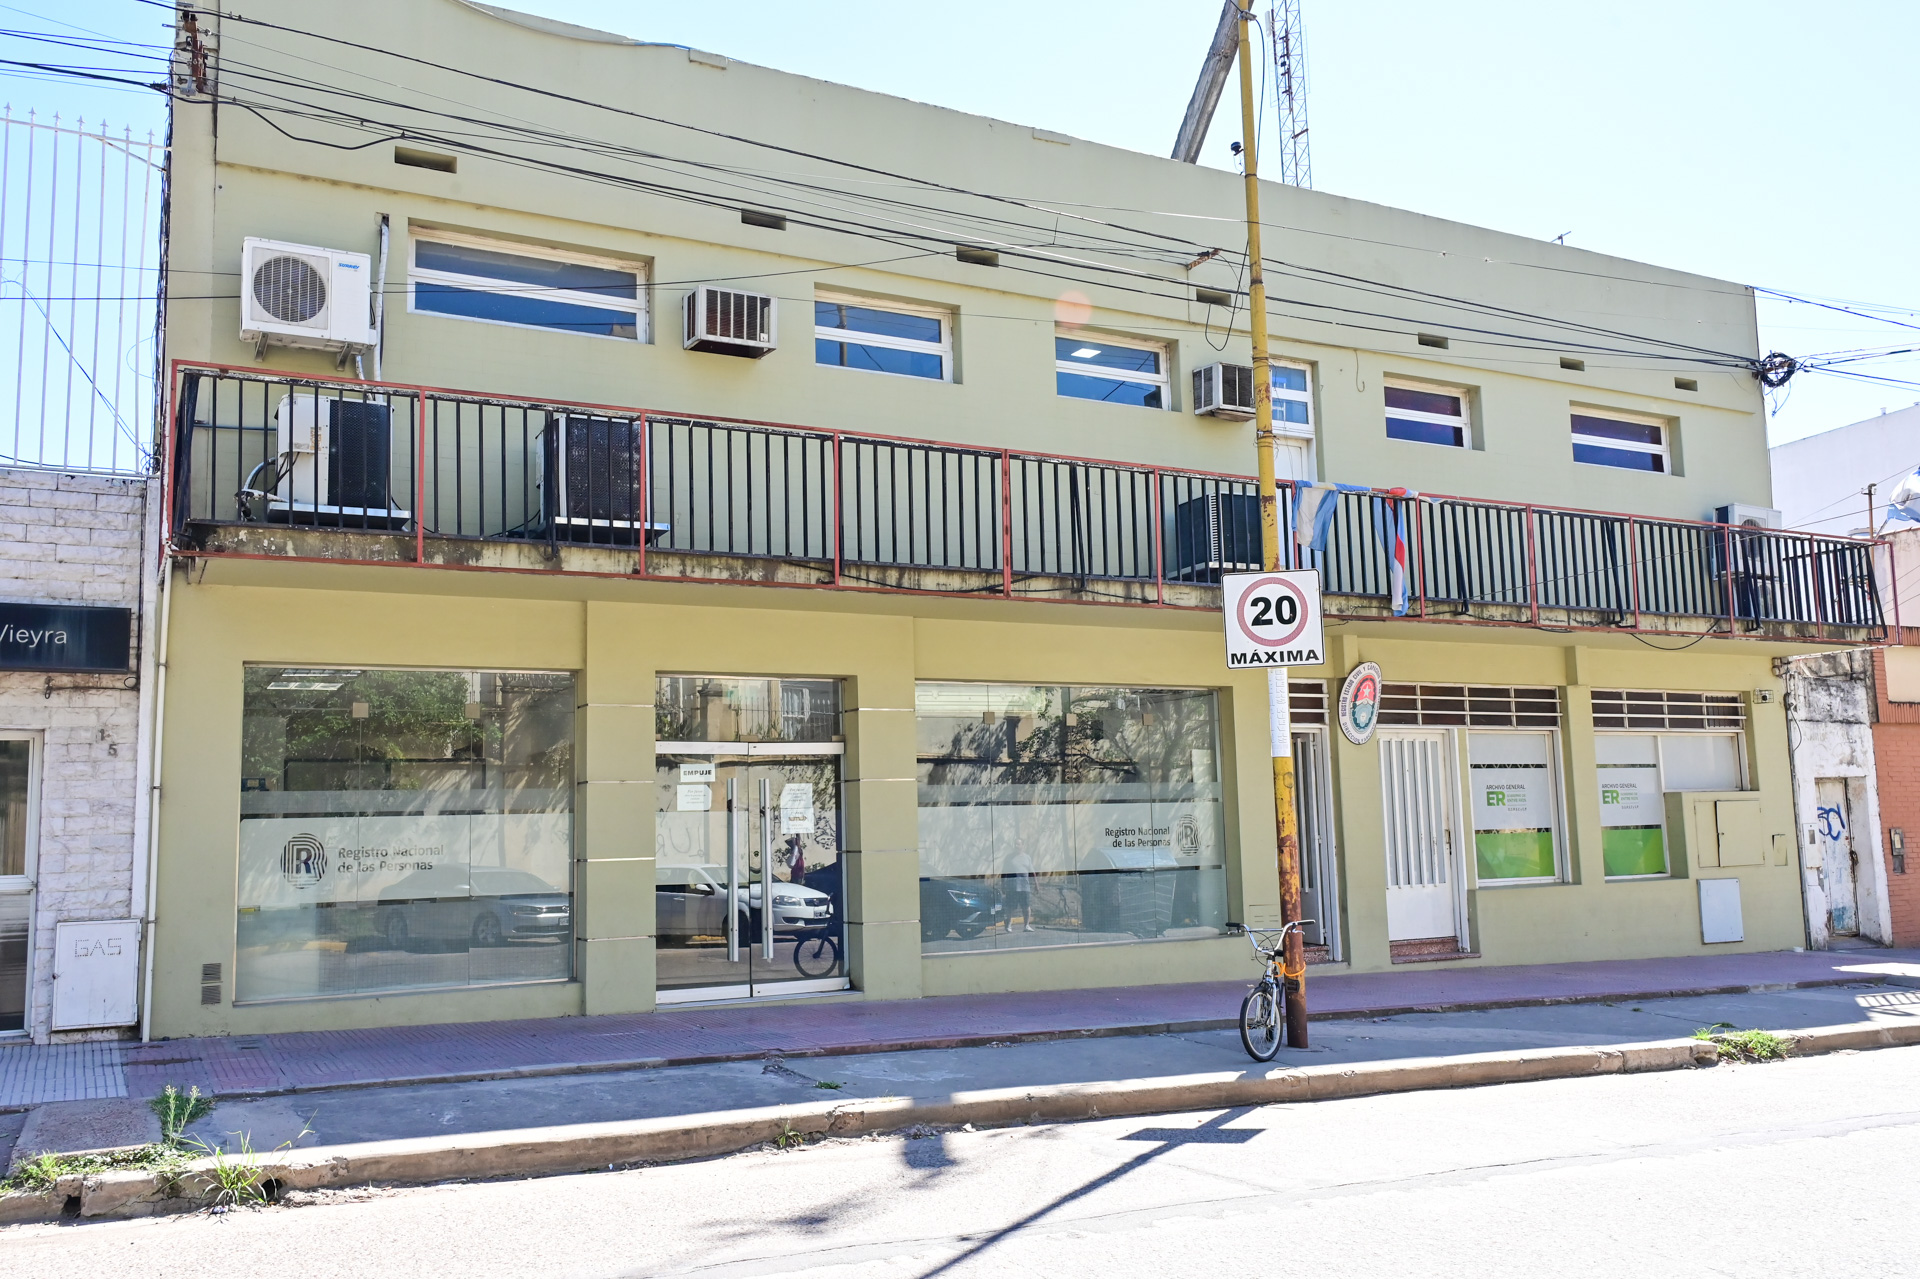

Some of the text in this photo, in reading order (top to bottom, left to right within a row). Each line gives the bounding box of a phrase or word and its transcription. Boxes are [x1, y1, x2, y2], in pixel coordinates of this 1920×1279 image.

[1250, 595, 1297, 627] 20
[1230, 649, 1320, 665] MÁXIMA
[1486, 791, 1506, 806] ER
[1602, 789, 1620, 804] ER
[1105, 826, 1170, 838] Registro Nacional
[1112, 838, 1171, 847] de las Personas
[338, 845, 444, 861] Registro Nacional
[337, 860, 434, 874] de las Personas
[75, 938, 122, 957] GAS
